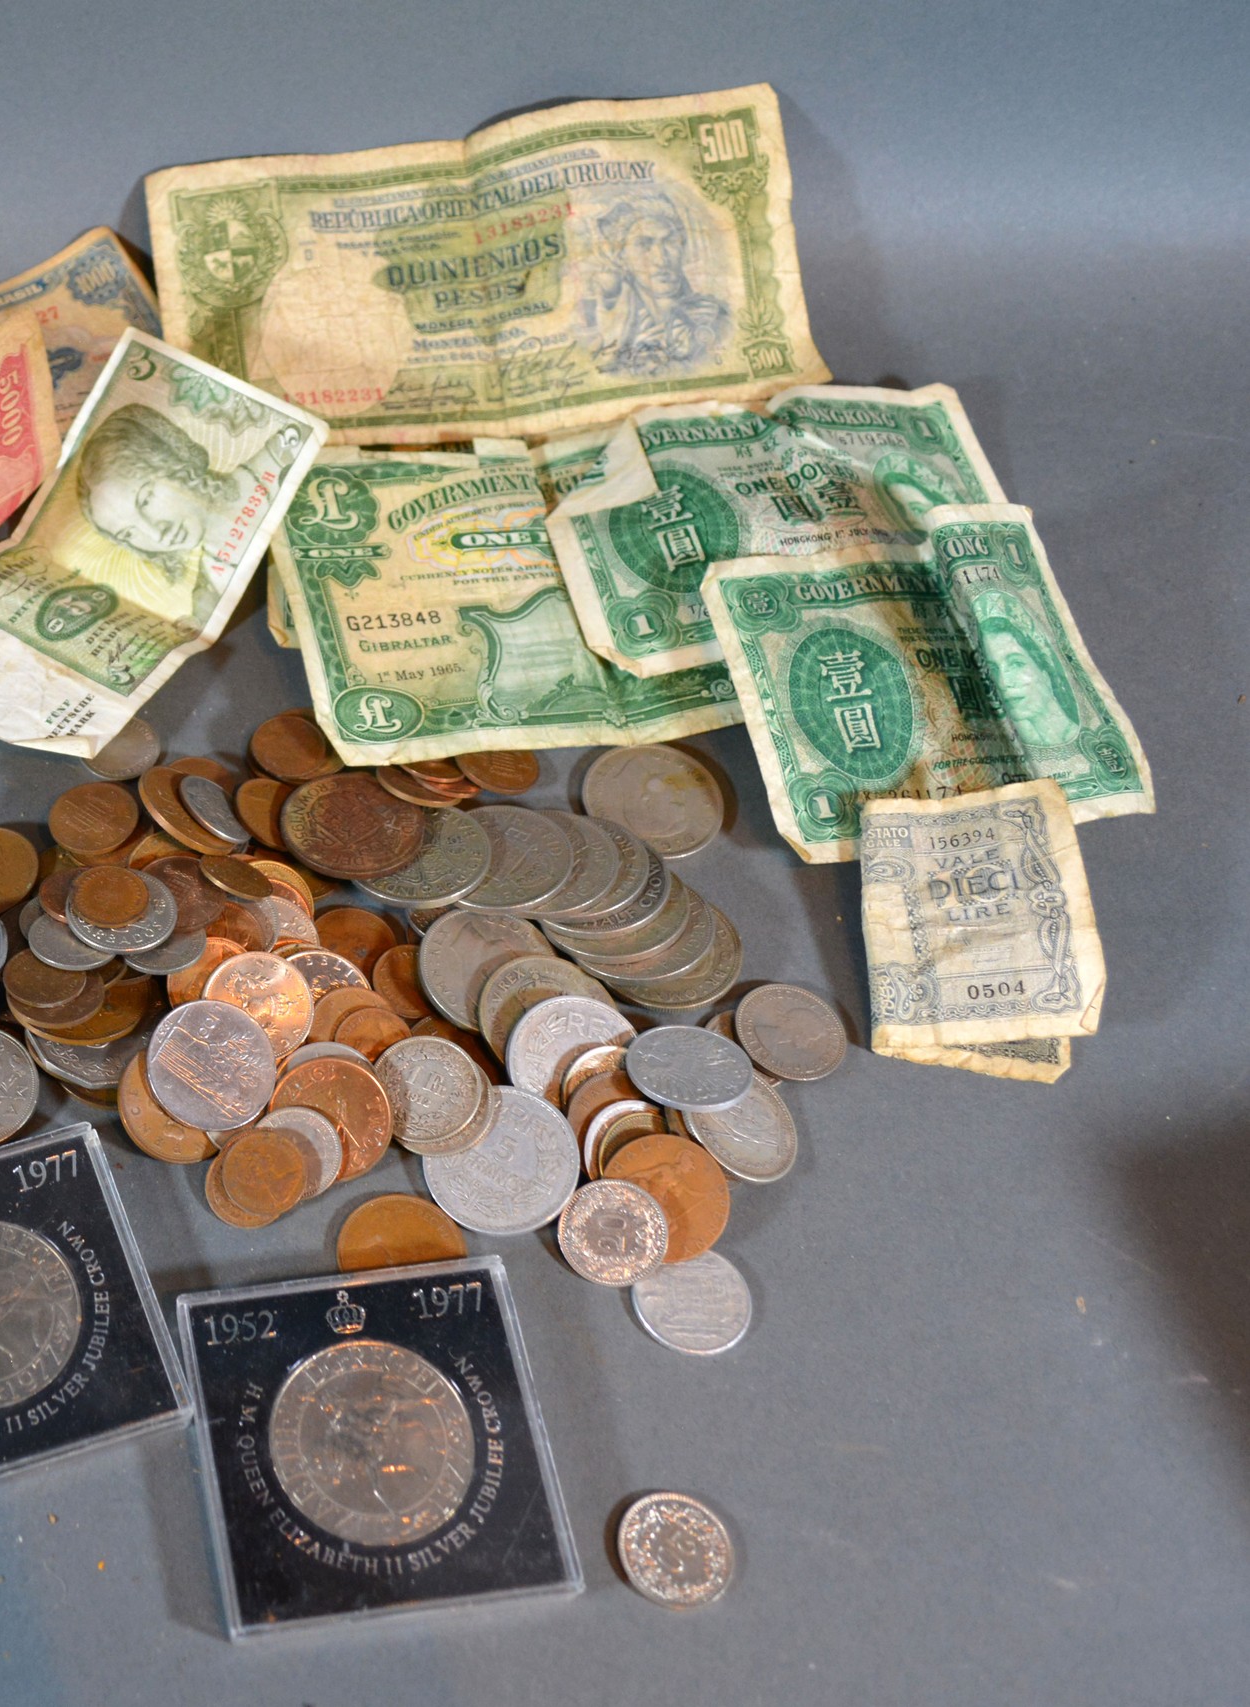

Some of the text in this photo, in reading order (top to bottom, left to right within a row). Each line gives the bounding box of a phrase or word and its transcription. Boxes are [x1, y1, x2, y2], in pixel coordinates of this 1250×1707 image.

[698, 120, 747, 162] 500
[520, 173, 561, 199] DEL
[563, 160, 656, 188] URUGUAY
[473, 201, 576, 246] 13182231
[386, 232, 563, 289] QUINIENTOS
[434, 276, 523, 310] PESOS
[35, 306, 60, 325] 27
[126, 348, 157, 381] 5
[750, 345, 784, 371] 500
[277, 425, 301, 449] 5
[735, 476, 783, 496] ONE
[387, 474, 532, 533] GOVERNMENT
[459, 531, 532, 546] ONE
[780, 533, 831, 548] HONGKONG
[1006, 543, 1024, 565] 1
[794, 572, 940, 603] GOVERNMENT
[346, 610, 443, 632] G213848
[631, 614, 656, 637] 1
[107, 663, 136, 686] 5
[395, 666, 426, 681] May
[812, 795, 835, 819] 1
[867, 826, 909, 839] STATO
[929, 827, 996, 850] 156394
[934, 848, 1001, 871] VALE
[928, 869, 1022, 900] DIECI
[947, 901, 1013, 922] LIRE
[967, 980, 1027, 1000] 0504
[12, 1149, 78, 1193] 1977
[57, 1219, 107, 1288] CROWN
[412, 1281, 483, 1320] 1977
[82, 1290, 111, 1372] JUBILEE
[204, 1309, 278, 1347] 1952
[28, 1371, 90, 1428] SILVER
[453, 1353, 503, 1434] CROWN
[4, 1416, 24, 1437] II
[236, 1433, 275, 1508] QUEEN
[468, 1438, 506, 1525] JUBILEE
[267, 1507, 380, 1577] ELIZABETH
[407, 1518, 478, 1573] SILVER
[384, 1556, 405, 1576] II
